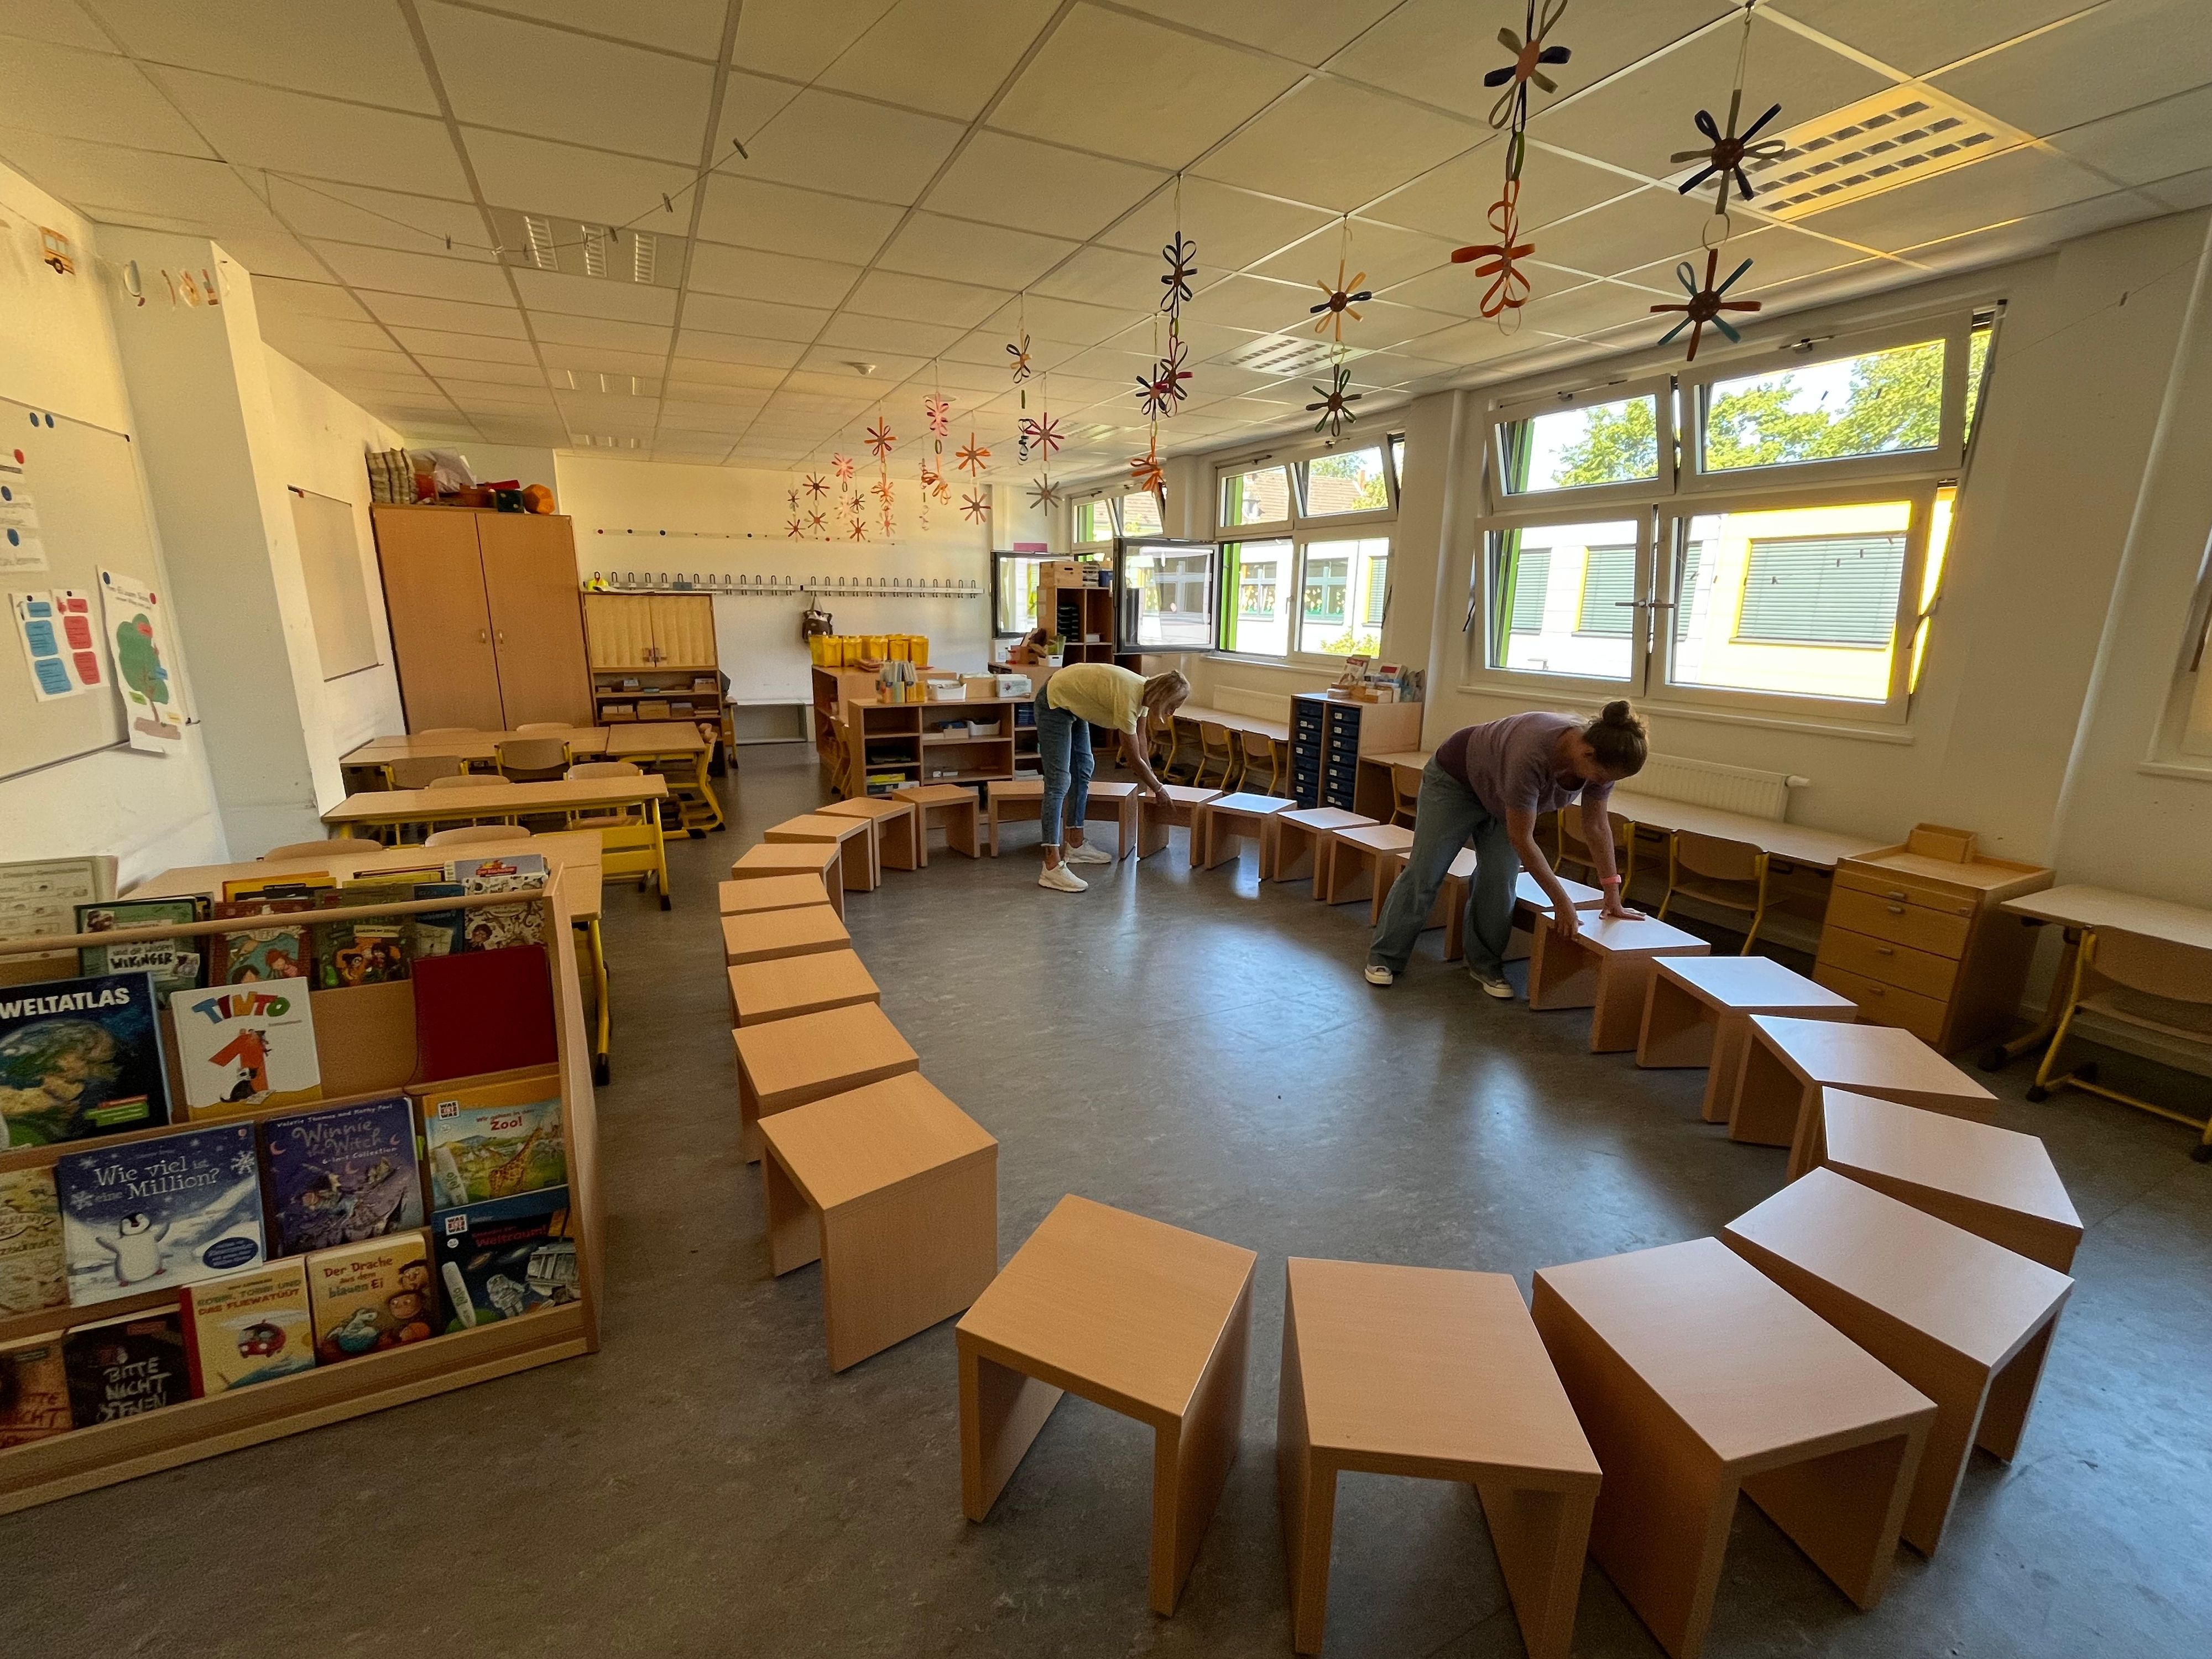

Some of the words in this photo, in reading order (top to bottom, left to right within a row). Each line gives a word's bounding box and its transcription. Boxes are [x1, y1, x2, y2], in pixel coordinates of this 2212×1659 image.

[110, 952, 173, 969] WIKINGER
[0, 987, 131, 1020] WELTATLAS
[191, 991, 291, 1024] TINTO
[276, 1119, 304, 1128] Valerie
[291, 1117, 372, 1147] Winnie
[490, 1115, 523, 1131] Zoo!
[325, 1128, 382, 1155] Witch
[353, 1147, 398, 1159] Collection
[93, 1164, 138, 1186] Wie
[144, 1156, 189, 1177] viel
[95, 1191, 123, 1202] eine
[127, 1167, 220, 1200] Million?
[476, 1224, 547, 1248] Weltraum!
[323, 1266, 347, 1279] Der
[349, 1256, 394, 1272] Drache
[339, 1275, 356, 1284] aus
[357, 1271, 377, 1281] dem
[278, 1279, 302, 1289] UND
[328, 1283, 369, 1299] blauen
[371, 1277, 384, 1290] Ei
[103, 1357, 161, 1383] BITTE
[105, 1372, 173, 1401] NICHT
